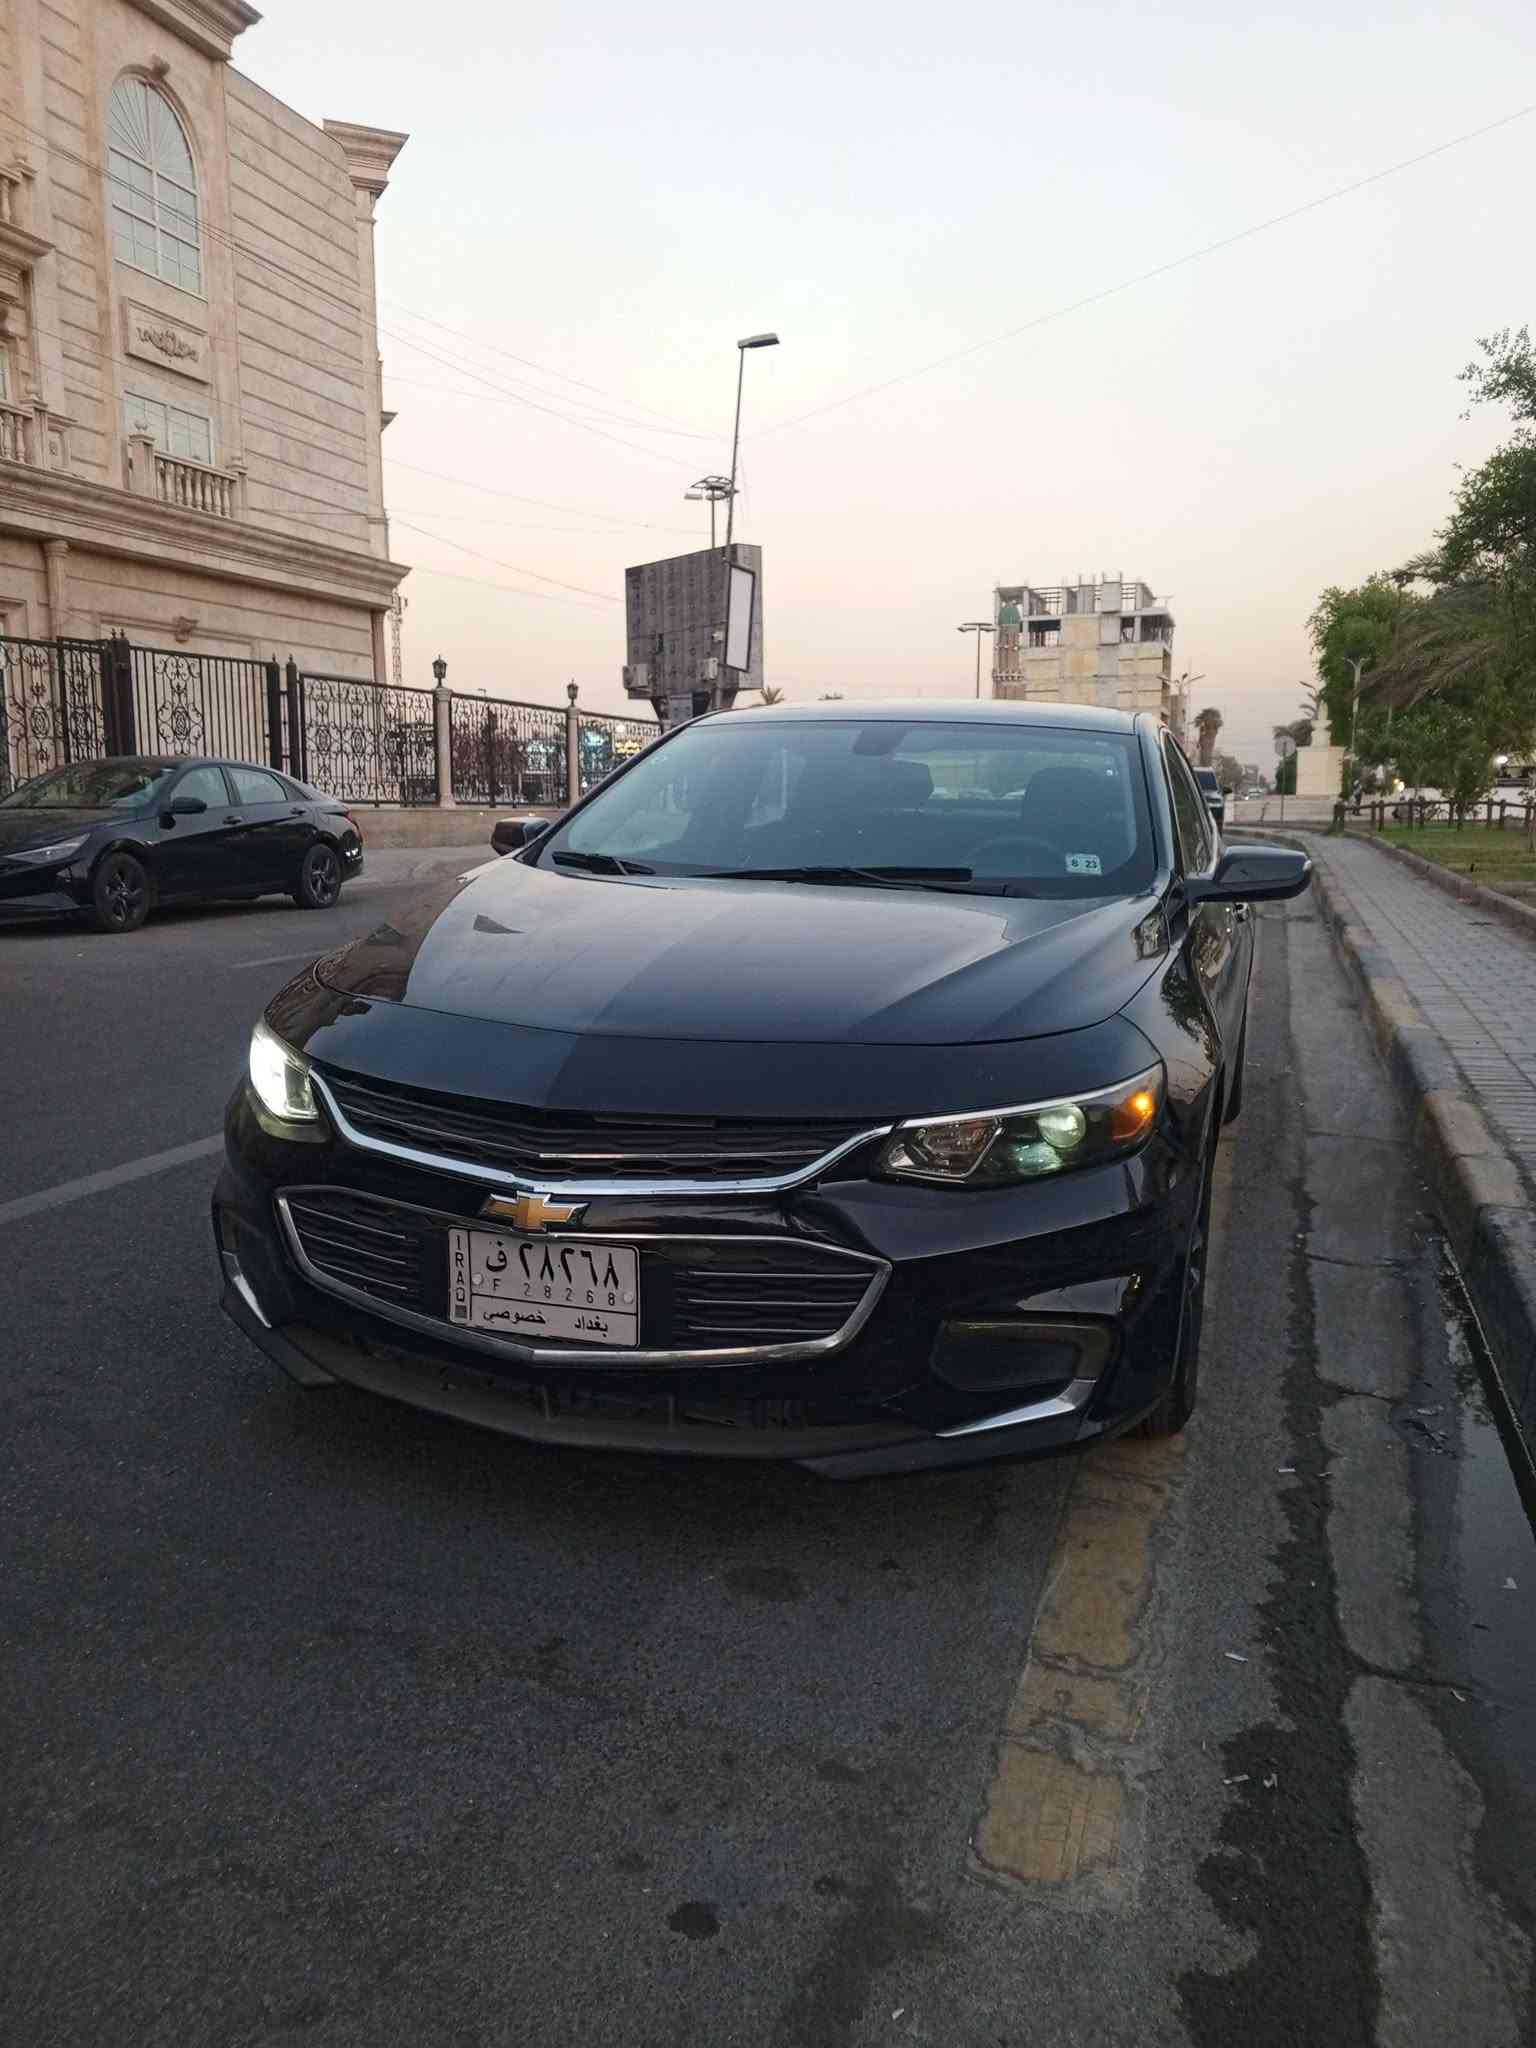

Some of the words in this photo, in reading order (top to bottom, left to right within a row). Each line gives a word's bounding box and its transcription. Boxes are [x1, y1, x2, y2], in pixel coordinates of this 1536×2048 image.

[454, 1235, 466, 1303] IRAQ
[485, 1239, 508, 1273] ف
[518, 1242, 620, 1290] ٢٨٢٦٨
[492, 1278, 502, 1292] F
[523, 1282, 616, 1306] 28268
[483, 1310, 547, 1325] خصوصي
[574, 1315, 609, 1338] بغداد
